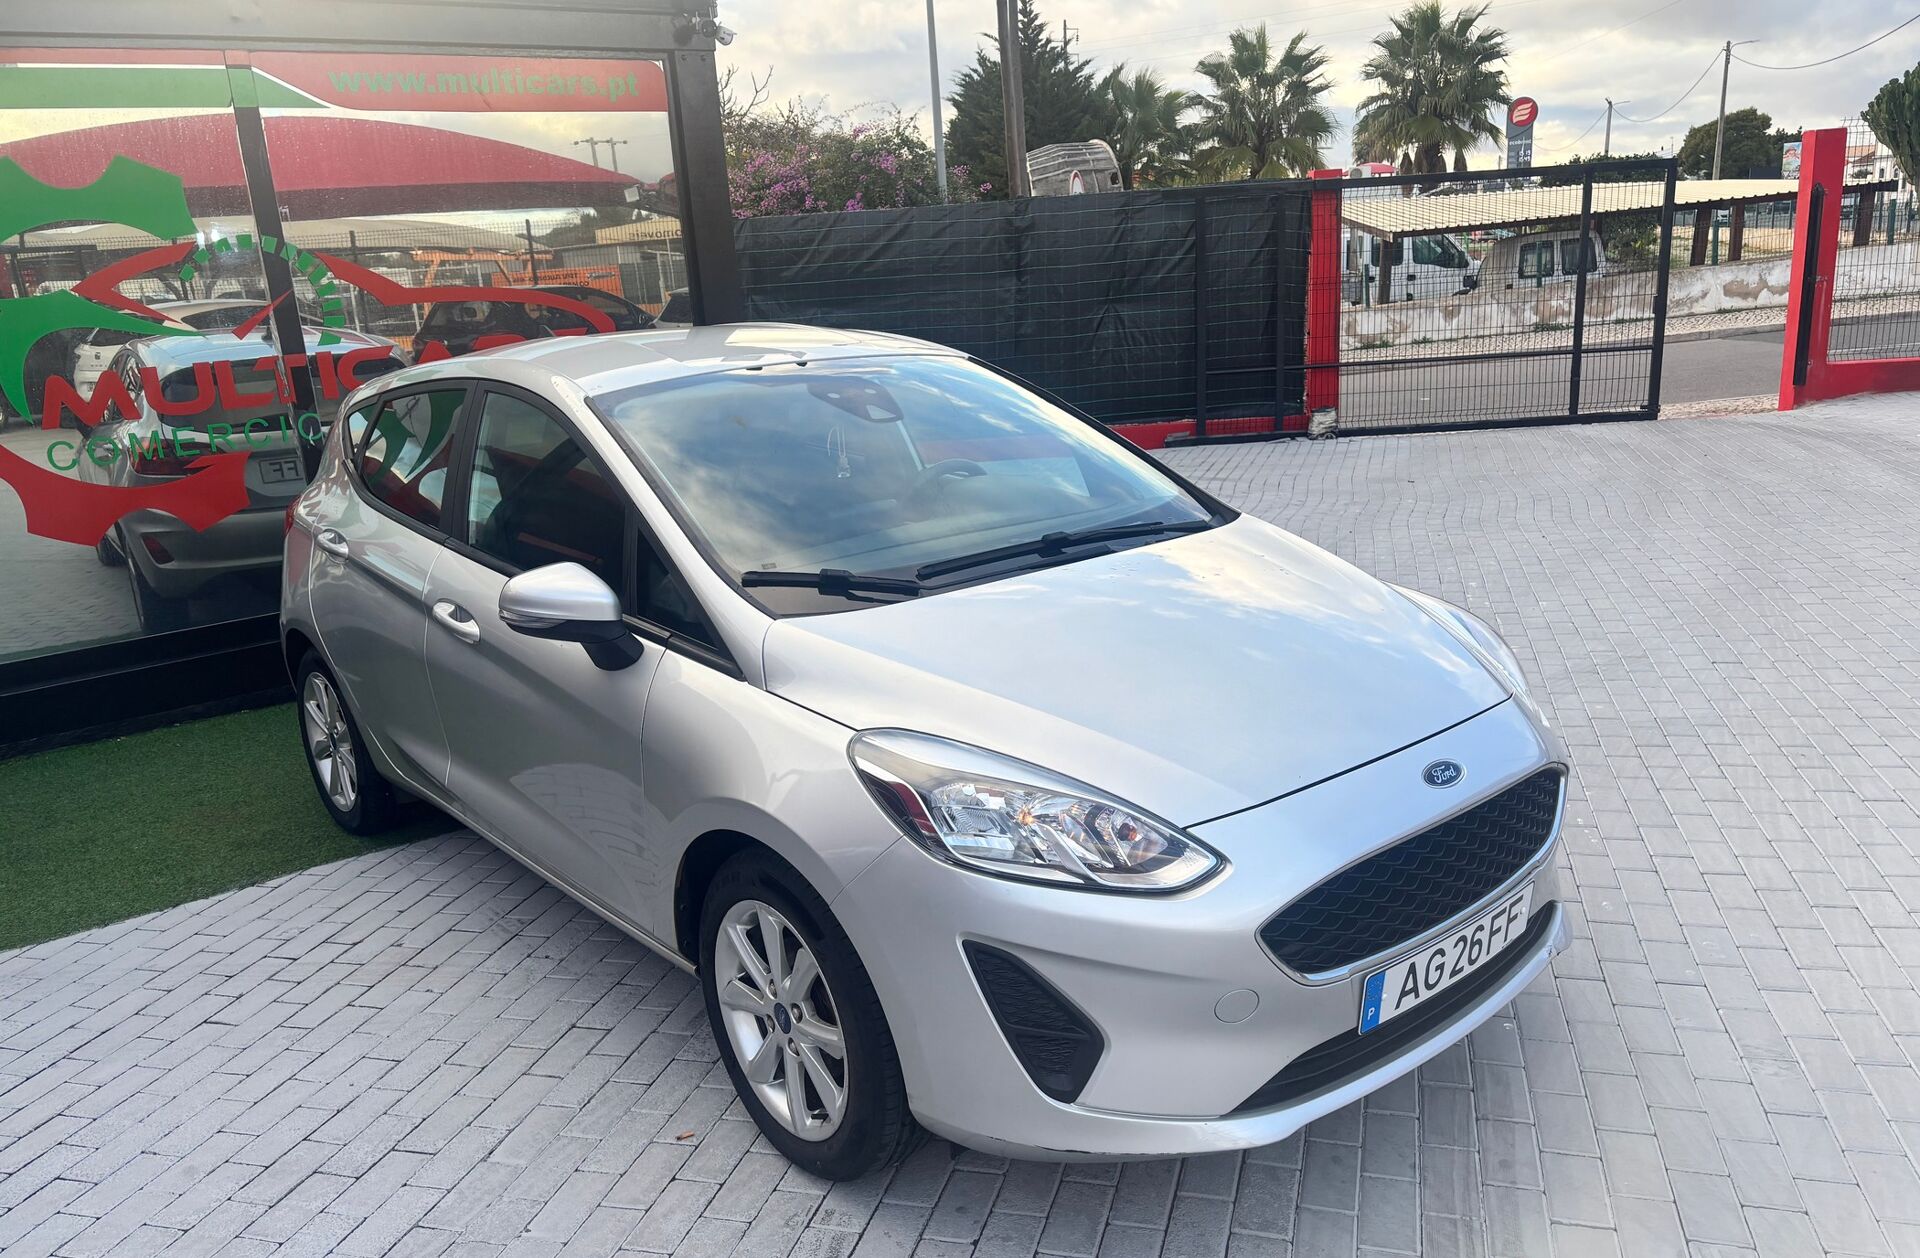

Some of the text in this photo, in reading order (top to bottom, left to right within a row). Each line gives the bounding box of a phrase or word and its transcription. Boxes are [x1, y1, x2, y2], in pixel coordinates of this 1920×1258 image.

[327, 67, 639, 103] www.multicars.pt
[1431, 764, 1457, 784] Ford
[1367, 1007, 1376, 1021] P
